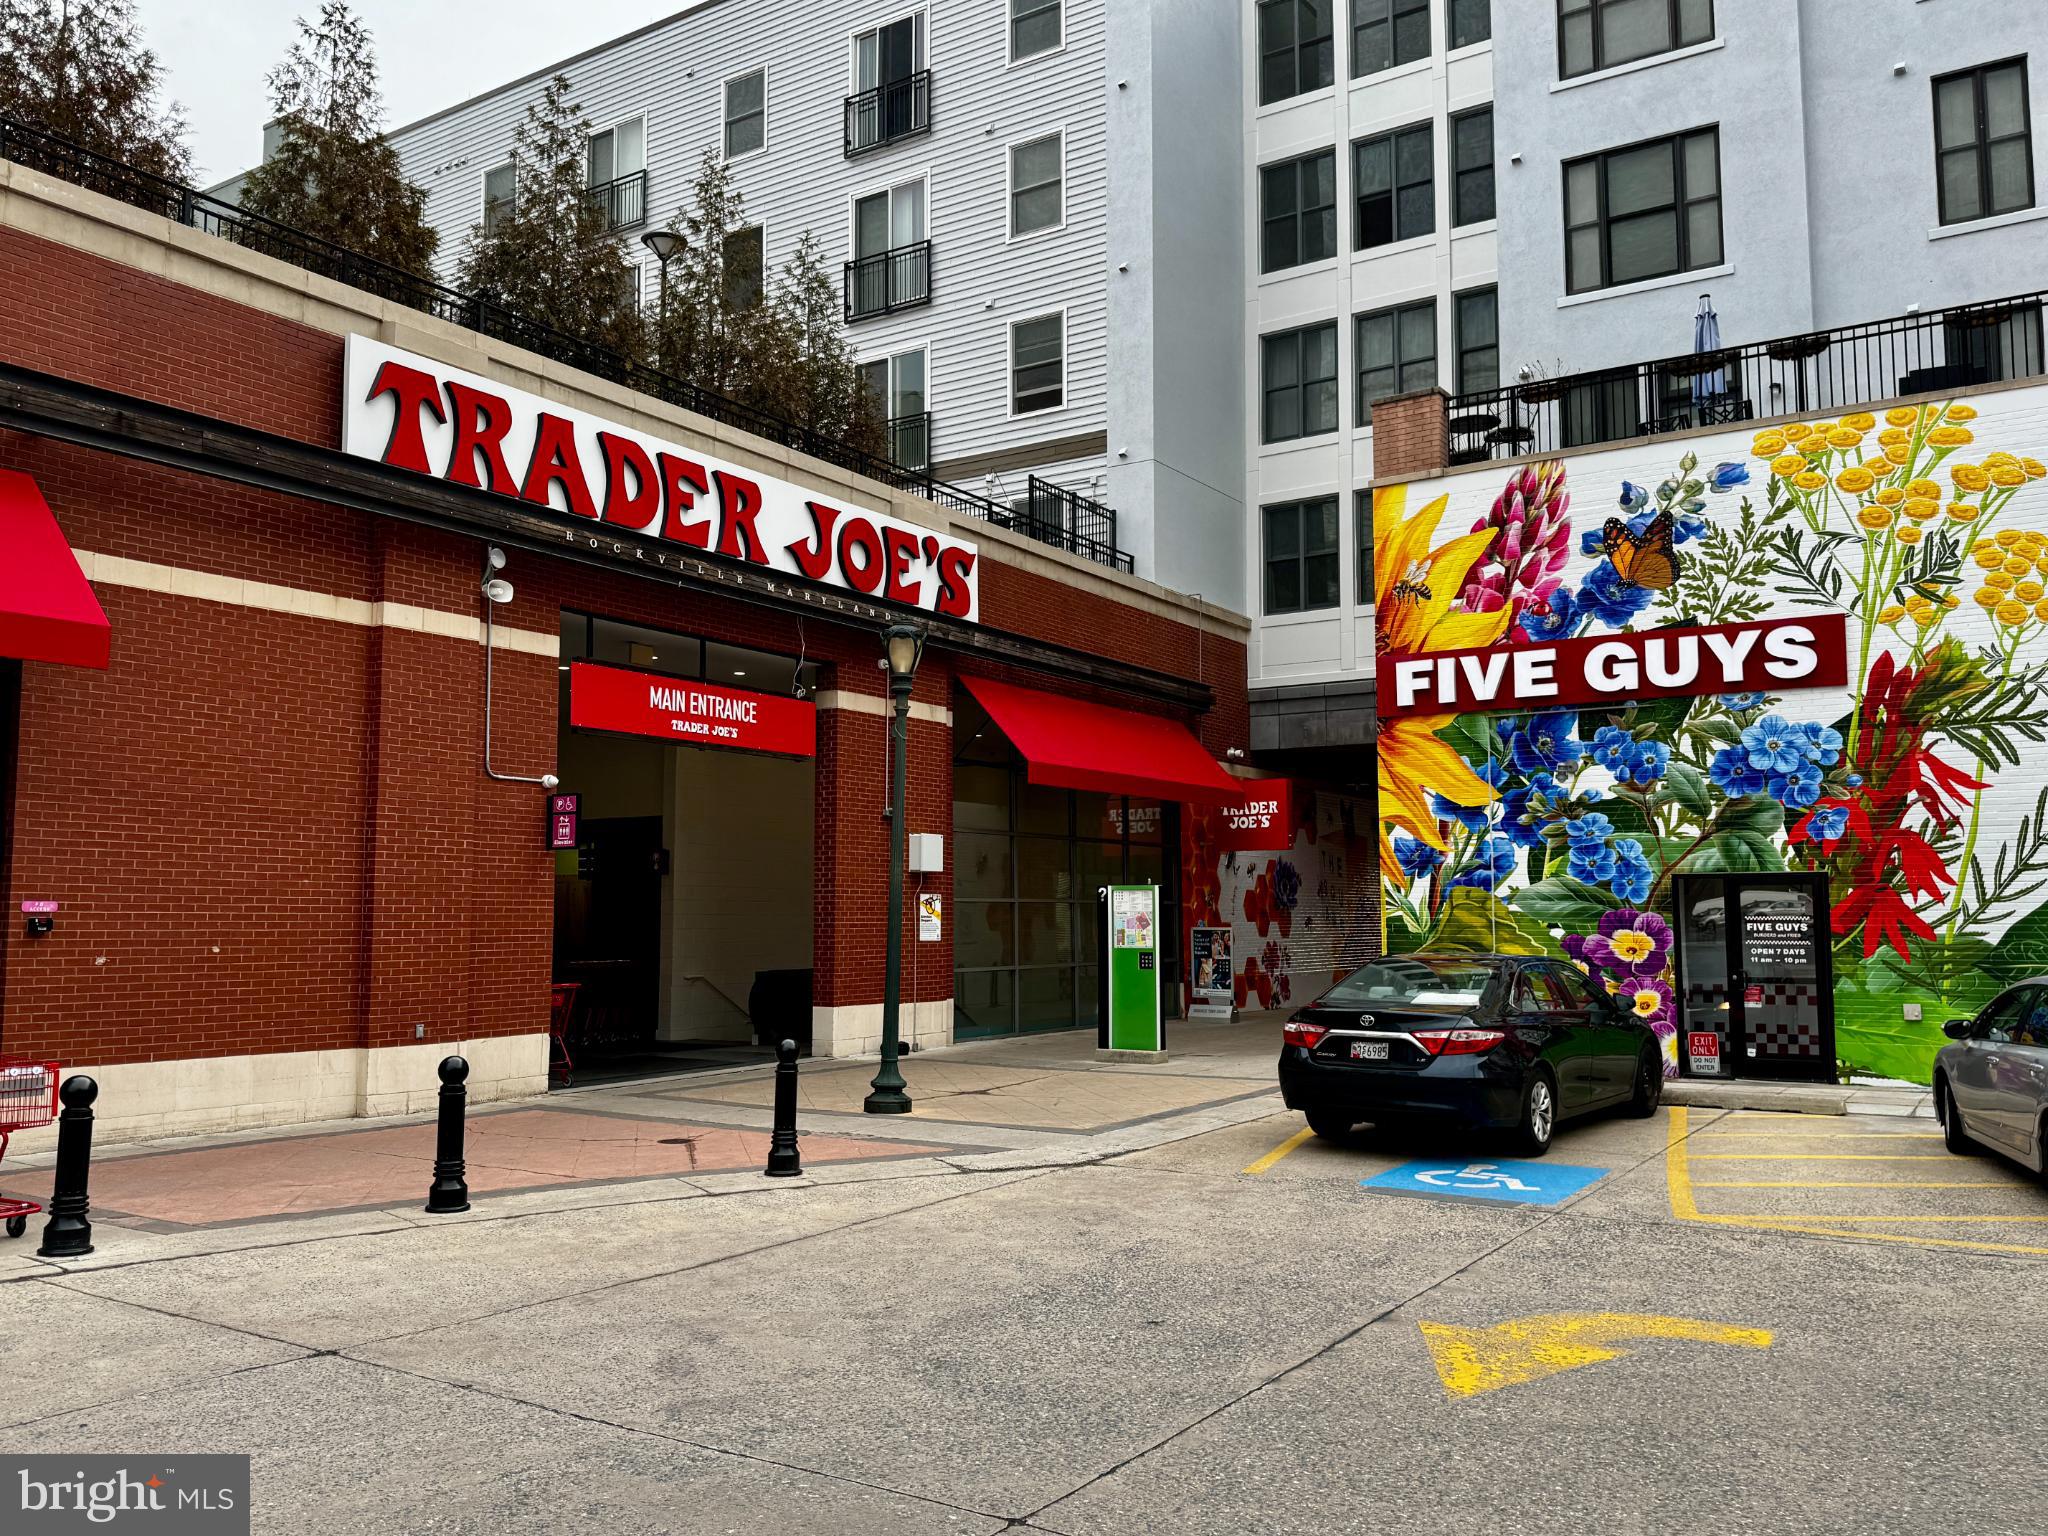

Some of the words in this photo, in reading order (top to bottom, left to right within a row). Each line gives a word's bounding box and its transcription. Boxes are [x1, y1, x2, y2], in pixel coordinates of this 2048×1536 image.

[365, 360, 770, 565] TRADER
[785, 500, 977, 619] JOE'S
[566, 530, 743, 584] ROCKVILLE
[767, 582, 891, 620] MARYLAND
[1396, 647, 1559, 707] FIVE
[1583, 625, 1819, 693] GUYS
[650, 685, 686, 713] MAIN
[690, 692, 757, 724] ENTRANCE
[671, 719, 709, 735] TRADER
[712, 725, 738, 739] JOE'S
[1228, 814, 1271, 830] JOE'S
[1746, 922, 1773, 931] FIVE
[1775, 922, 1808, 932] GUYS
[1783, 948, 1806, 956] DAYS
[1694, 1036, 1713, 1046] EXIT
[1692, 1046, 1716, 1055] ONLY
